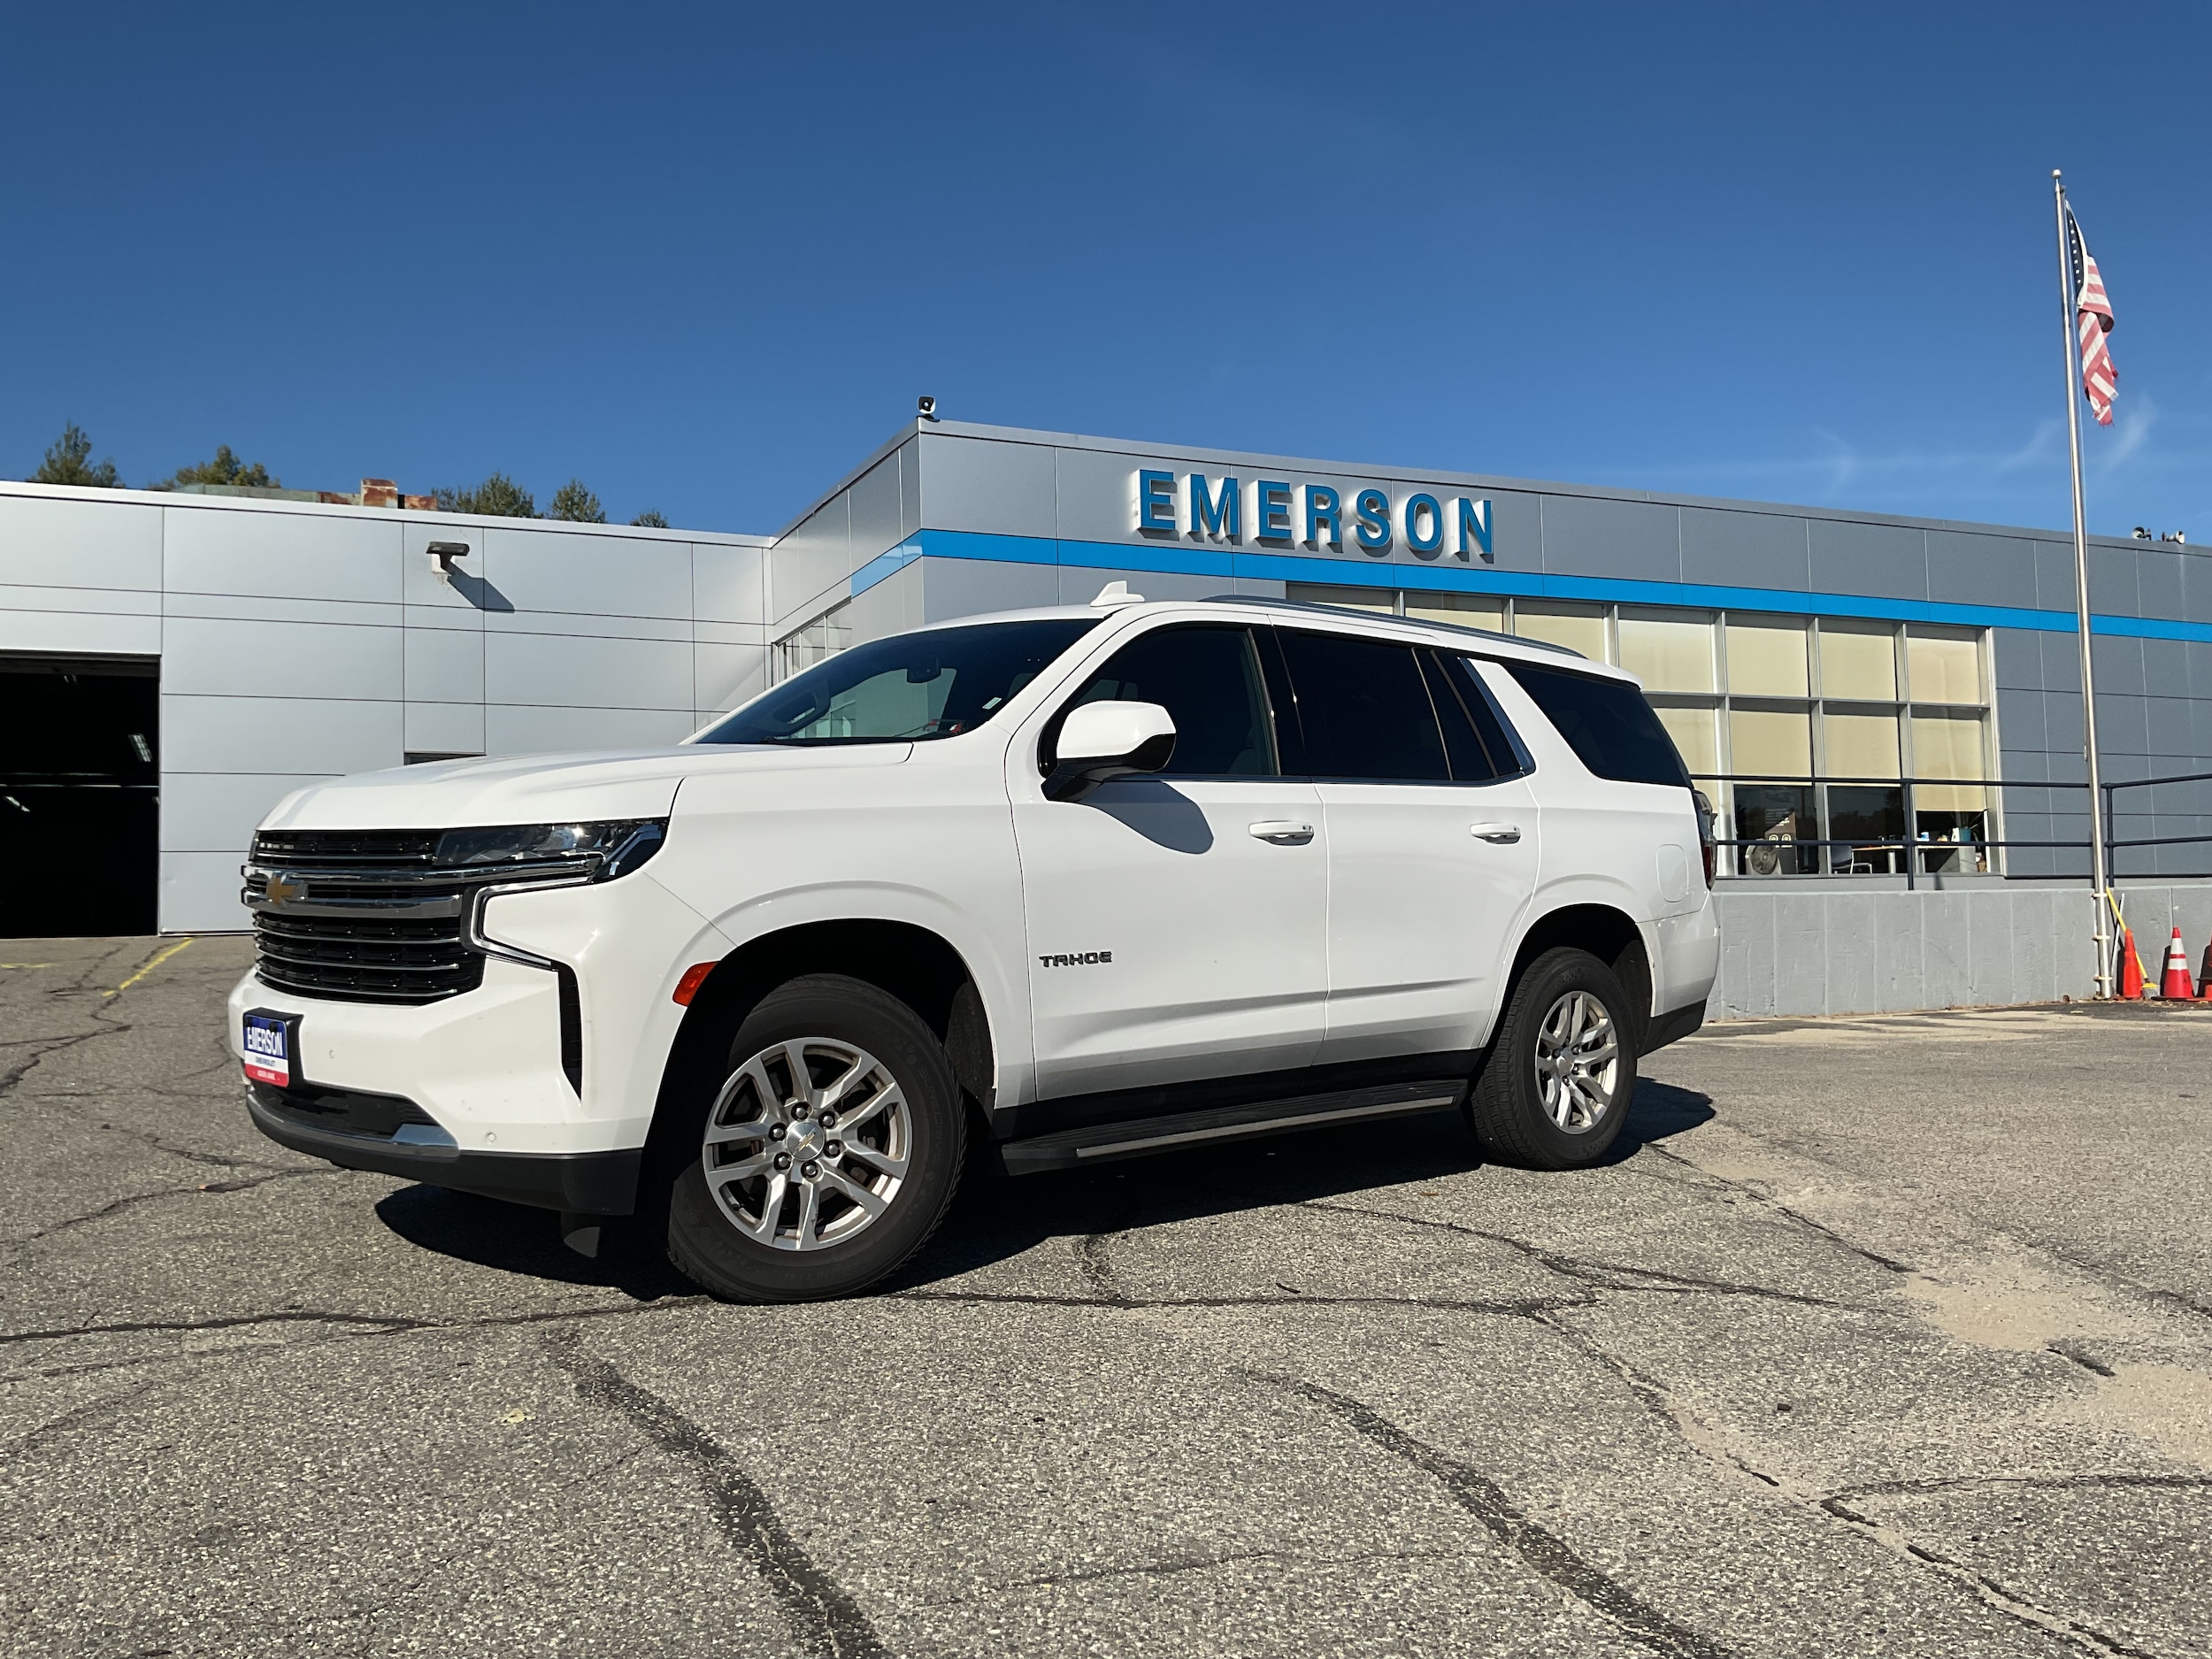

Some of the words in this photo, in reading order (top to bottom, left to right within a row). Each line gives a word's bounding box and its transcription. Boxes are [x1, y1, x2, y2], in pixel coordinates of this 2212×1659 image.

[1137, 469, 1494, 555] EMERSON
[1039, 951, 1112, 967] TAHOE
[247, 1026, 283, 1056] EMERSON
